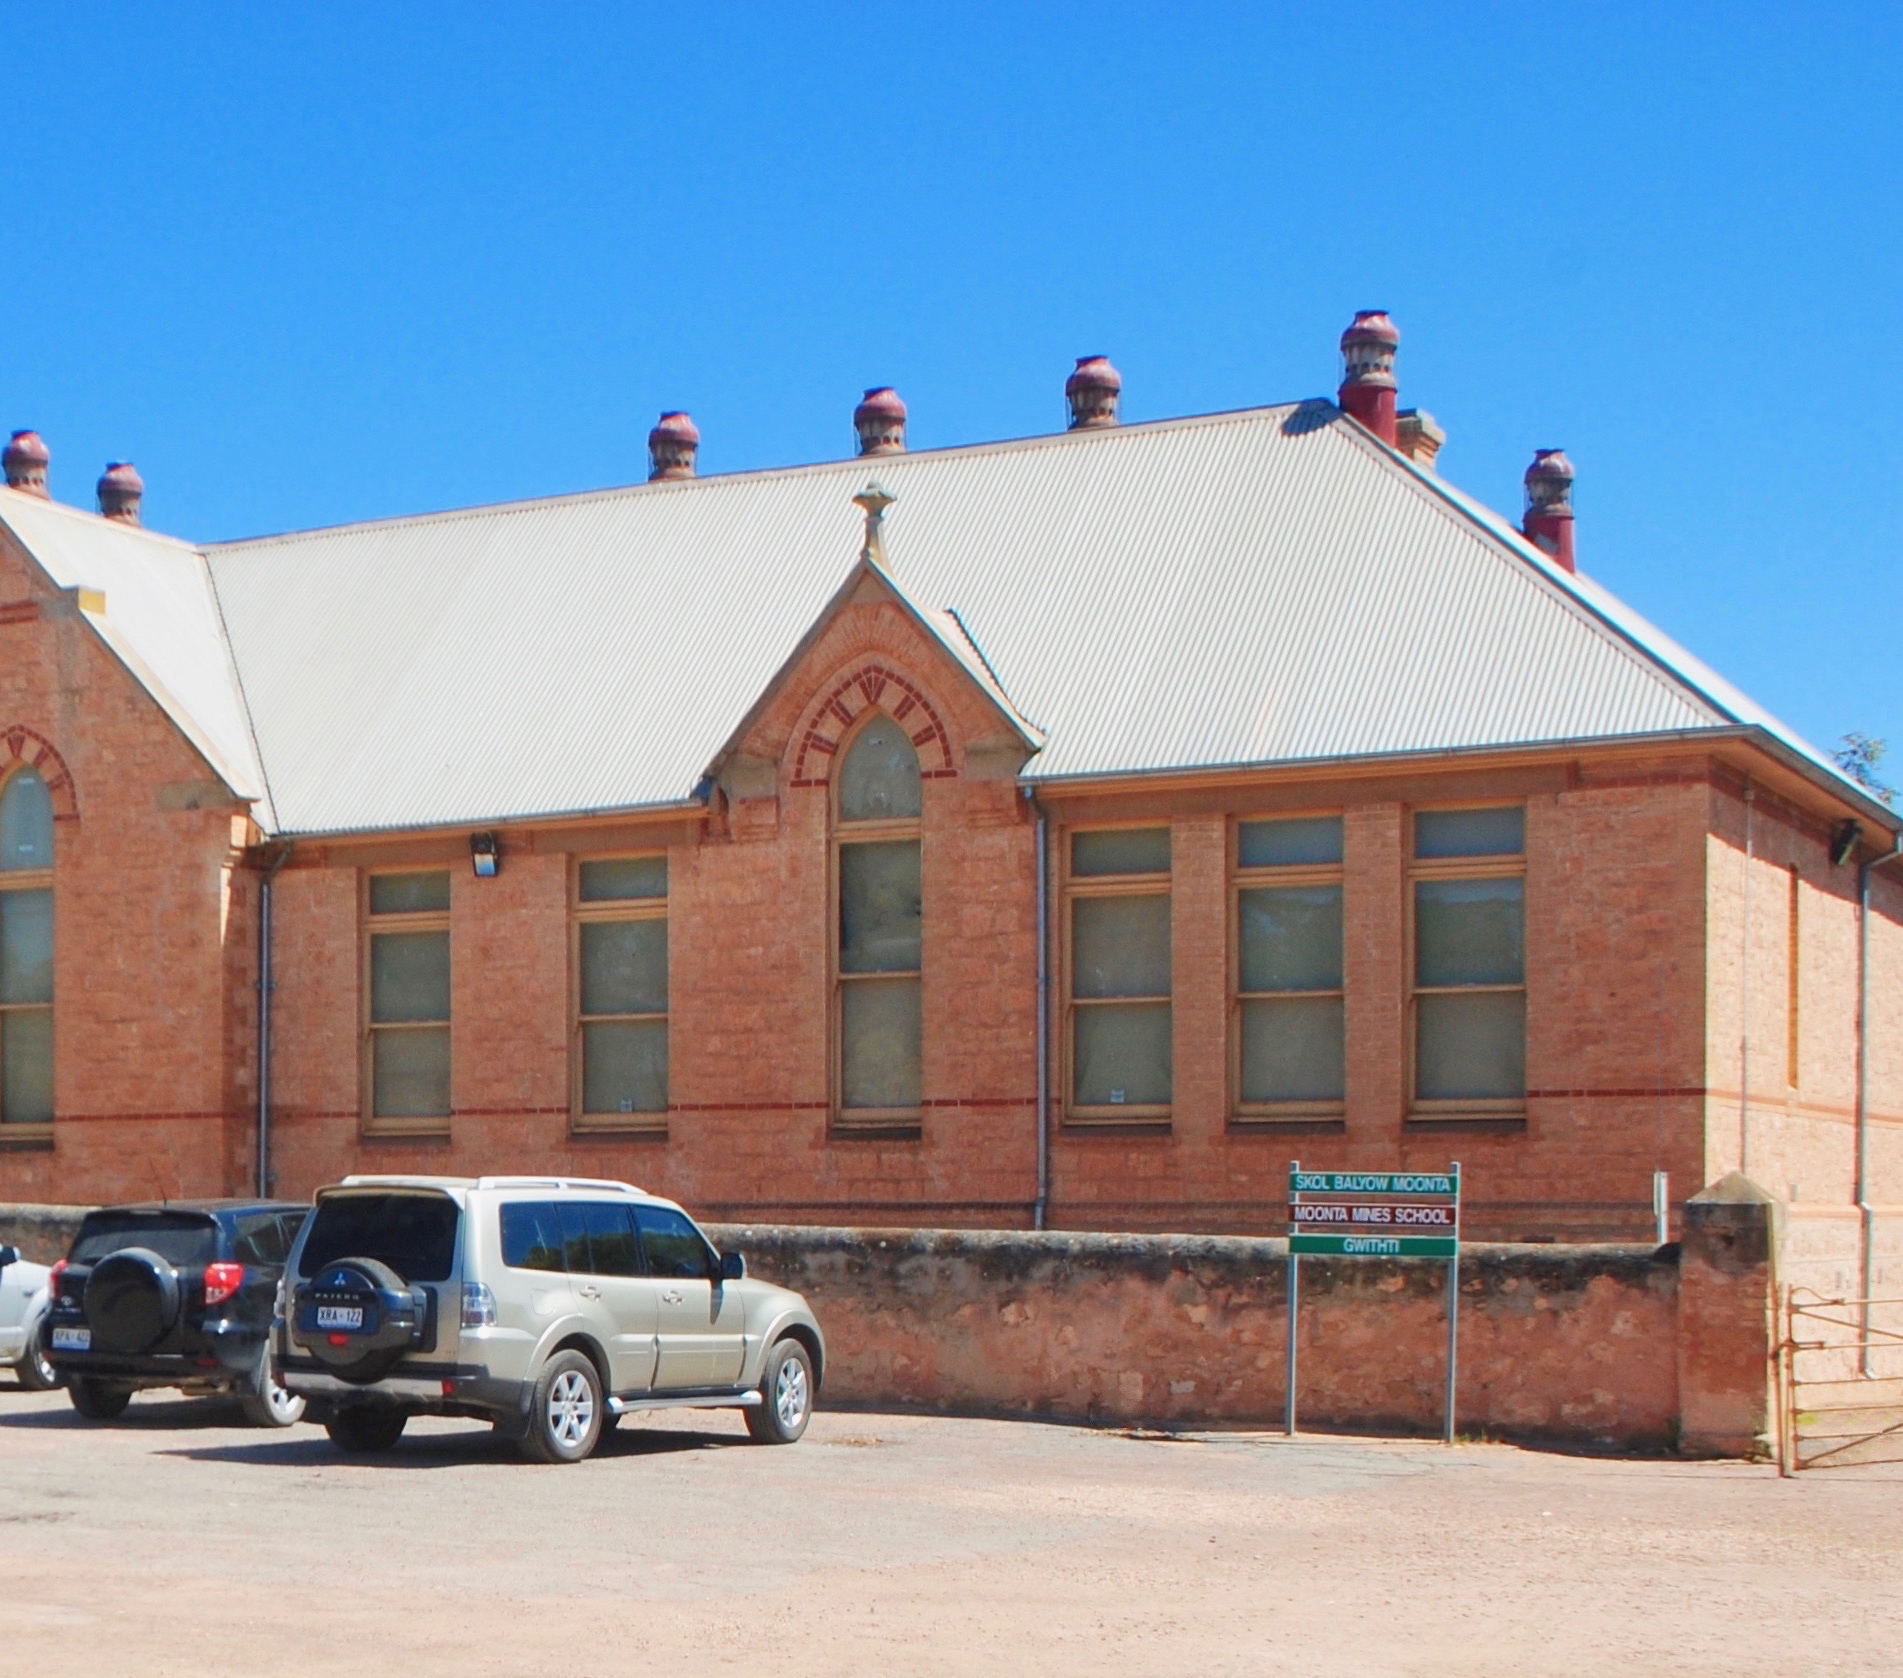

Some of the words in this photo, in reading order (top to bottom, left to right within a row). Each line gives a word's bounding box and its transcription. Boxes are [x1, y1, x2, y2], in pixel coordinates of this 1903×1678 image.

[1296, 1175, 1330, 1190] SKOL
[1334, 1175, 1389, 1191] BALYOW
[1392, 1177, 1452, 1192] MOONTA
[1294, 1206, 1348, 1221] MOONTA
[1352, 1207, 1391, 1223] MINES
[1395, 1208, 1450, 1224] SCHOOL
[1343, 1239, 1400, 1253] GWITHTI
